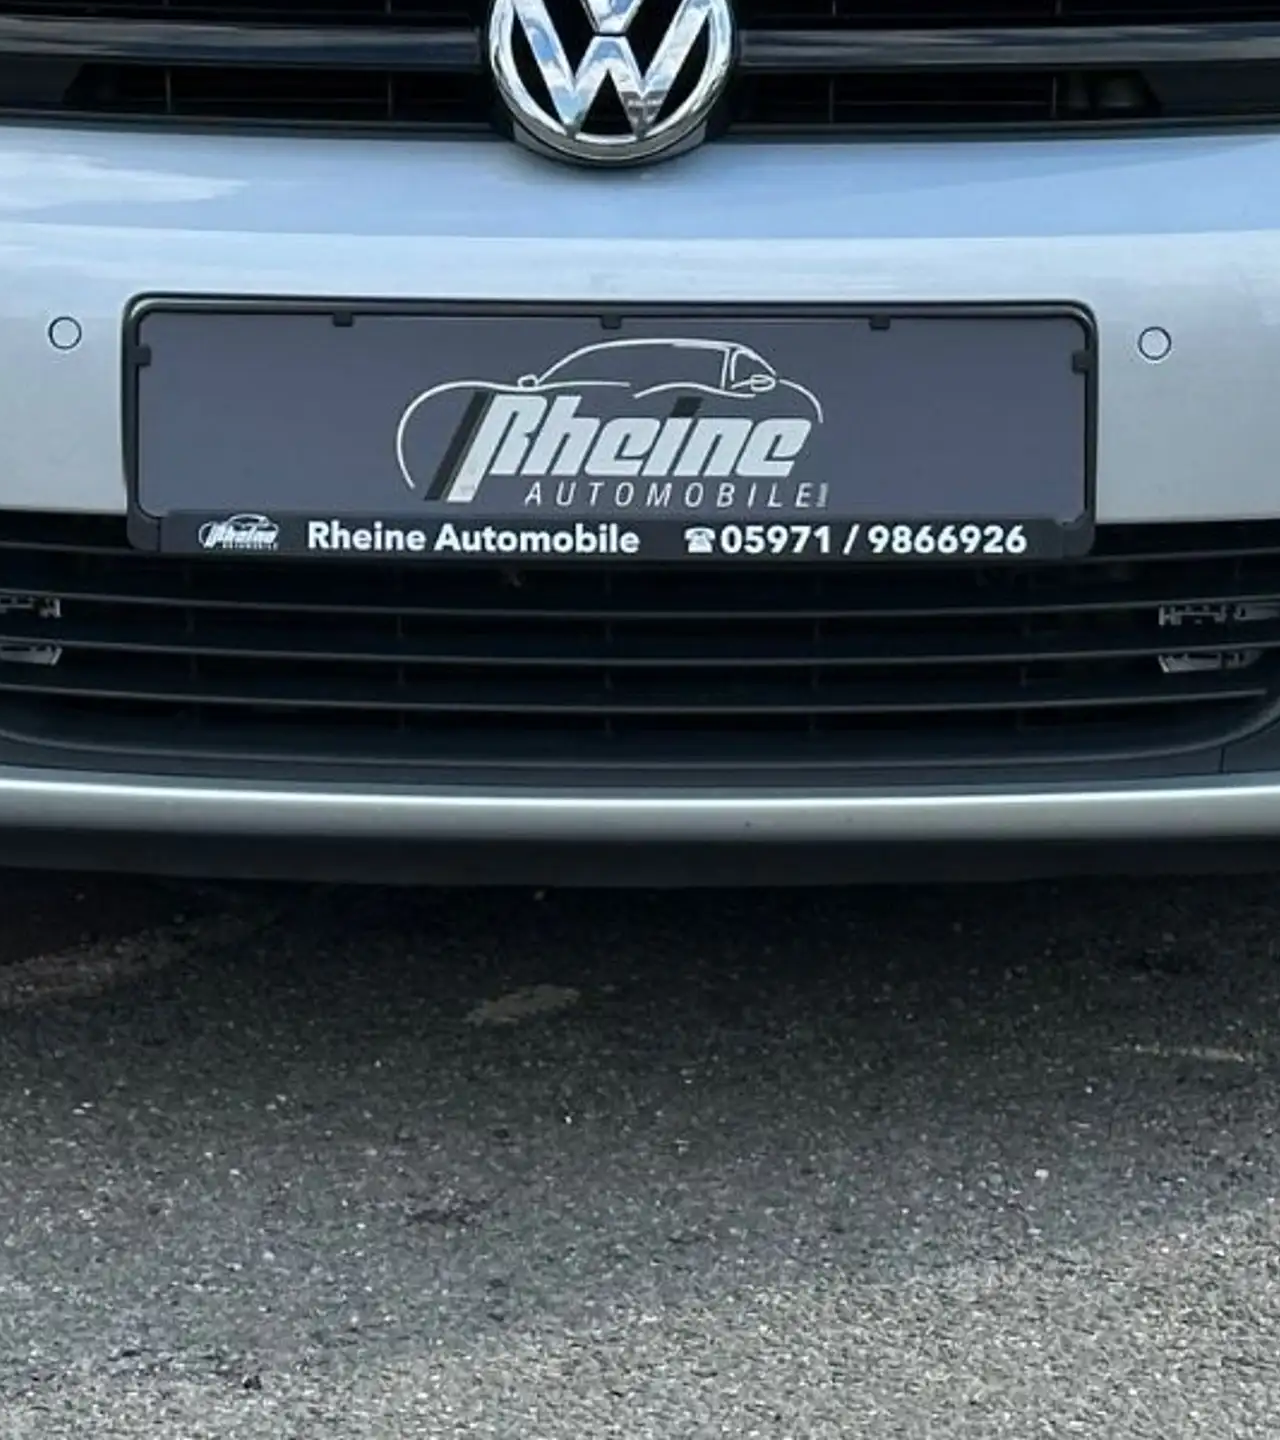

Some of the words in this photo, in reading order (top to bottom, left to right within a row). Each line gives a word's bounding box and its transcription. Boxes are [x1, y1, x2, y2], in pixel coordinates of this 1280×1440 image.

[448, 394, 813, 503] Rheine
[523, 480, 816, 509] AUTOMOBILE
[307, 520, 426, 552] Rheine
[433, 522, 641, 554] Automobile
[720, 524, 831, 555] 05971
[867, 524, 1028, 555] 9866926
